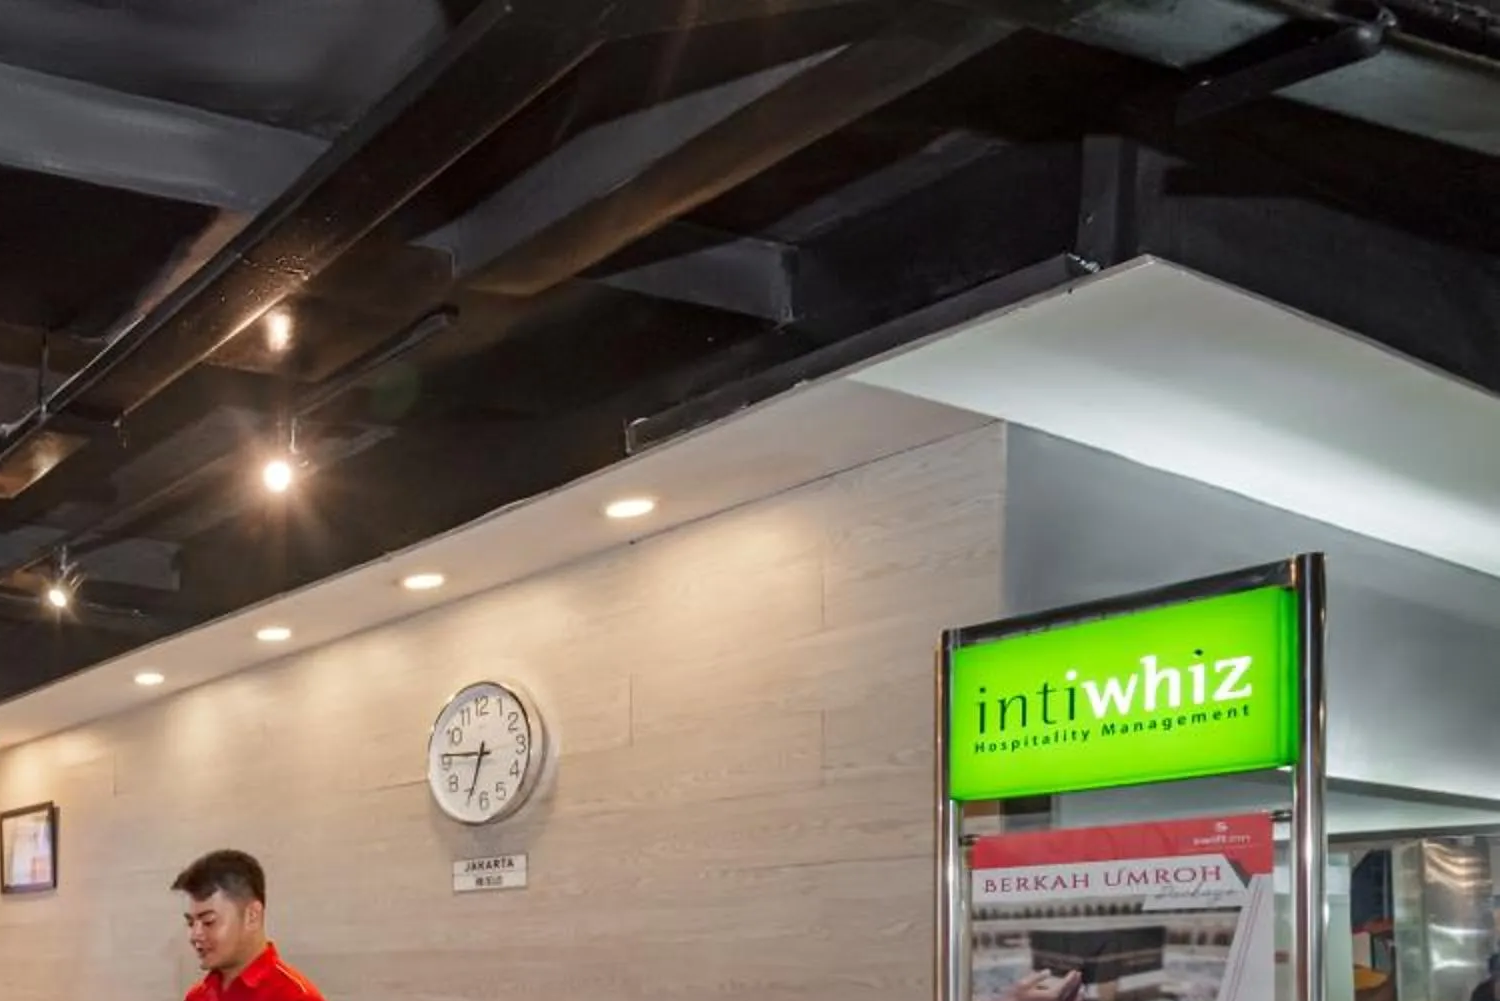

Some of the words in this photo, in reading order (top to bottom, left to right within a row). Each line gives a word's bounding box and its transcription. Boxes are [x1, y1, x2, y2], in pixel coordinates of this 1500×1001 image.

[977, 648, 1253, 734] intiwhiz
[474, 696, 489, 717] 12
[496, 698, 503, 716] 1
[460, 707, 471, 727] 11
[507, 712, 518, 732] 2
[448, 727, 463, 746] 10
[973, 727, 1091, 753] Hospitality
[1100, 703, 1251, 737] Management
[514, 735, 526, 755] 3
[509, 760, 519, 778] 4
[449, 775, 459, 793] 8
[495, 781, 506, 802] 5
[478, 791, 489, 812] 6
[463, 857, 515, 873] JAKARTA
[984, 872, 1090, 893] BERKAH
[1103, 865, 1222, 888] UMROH
